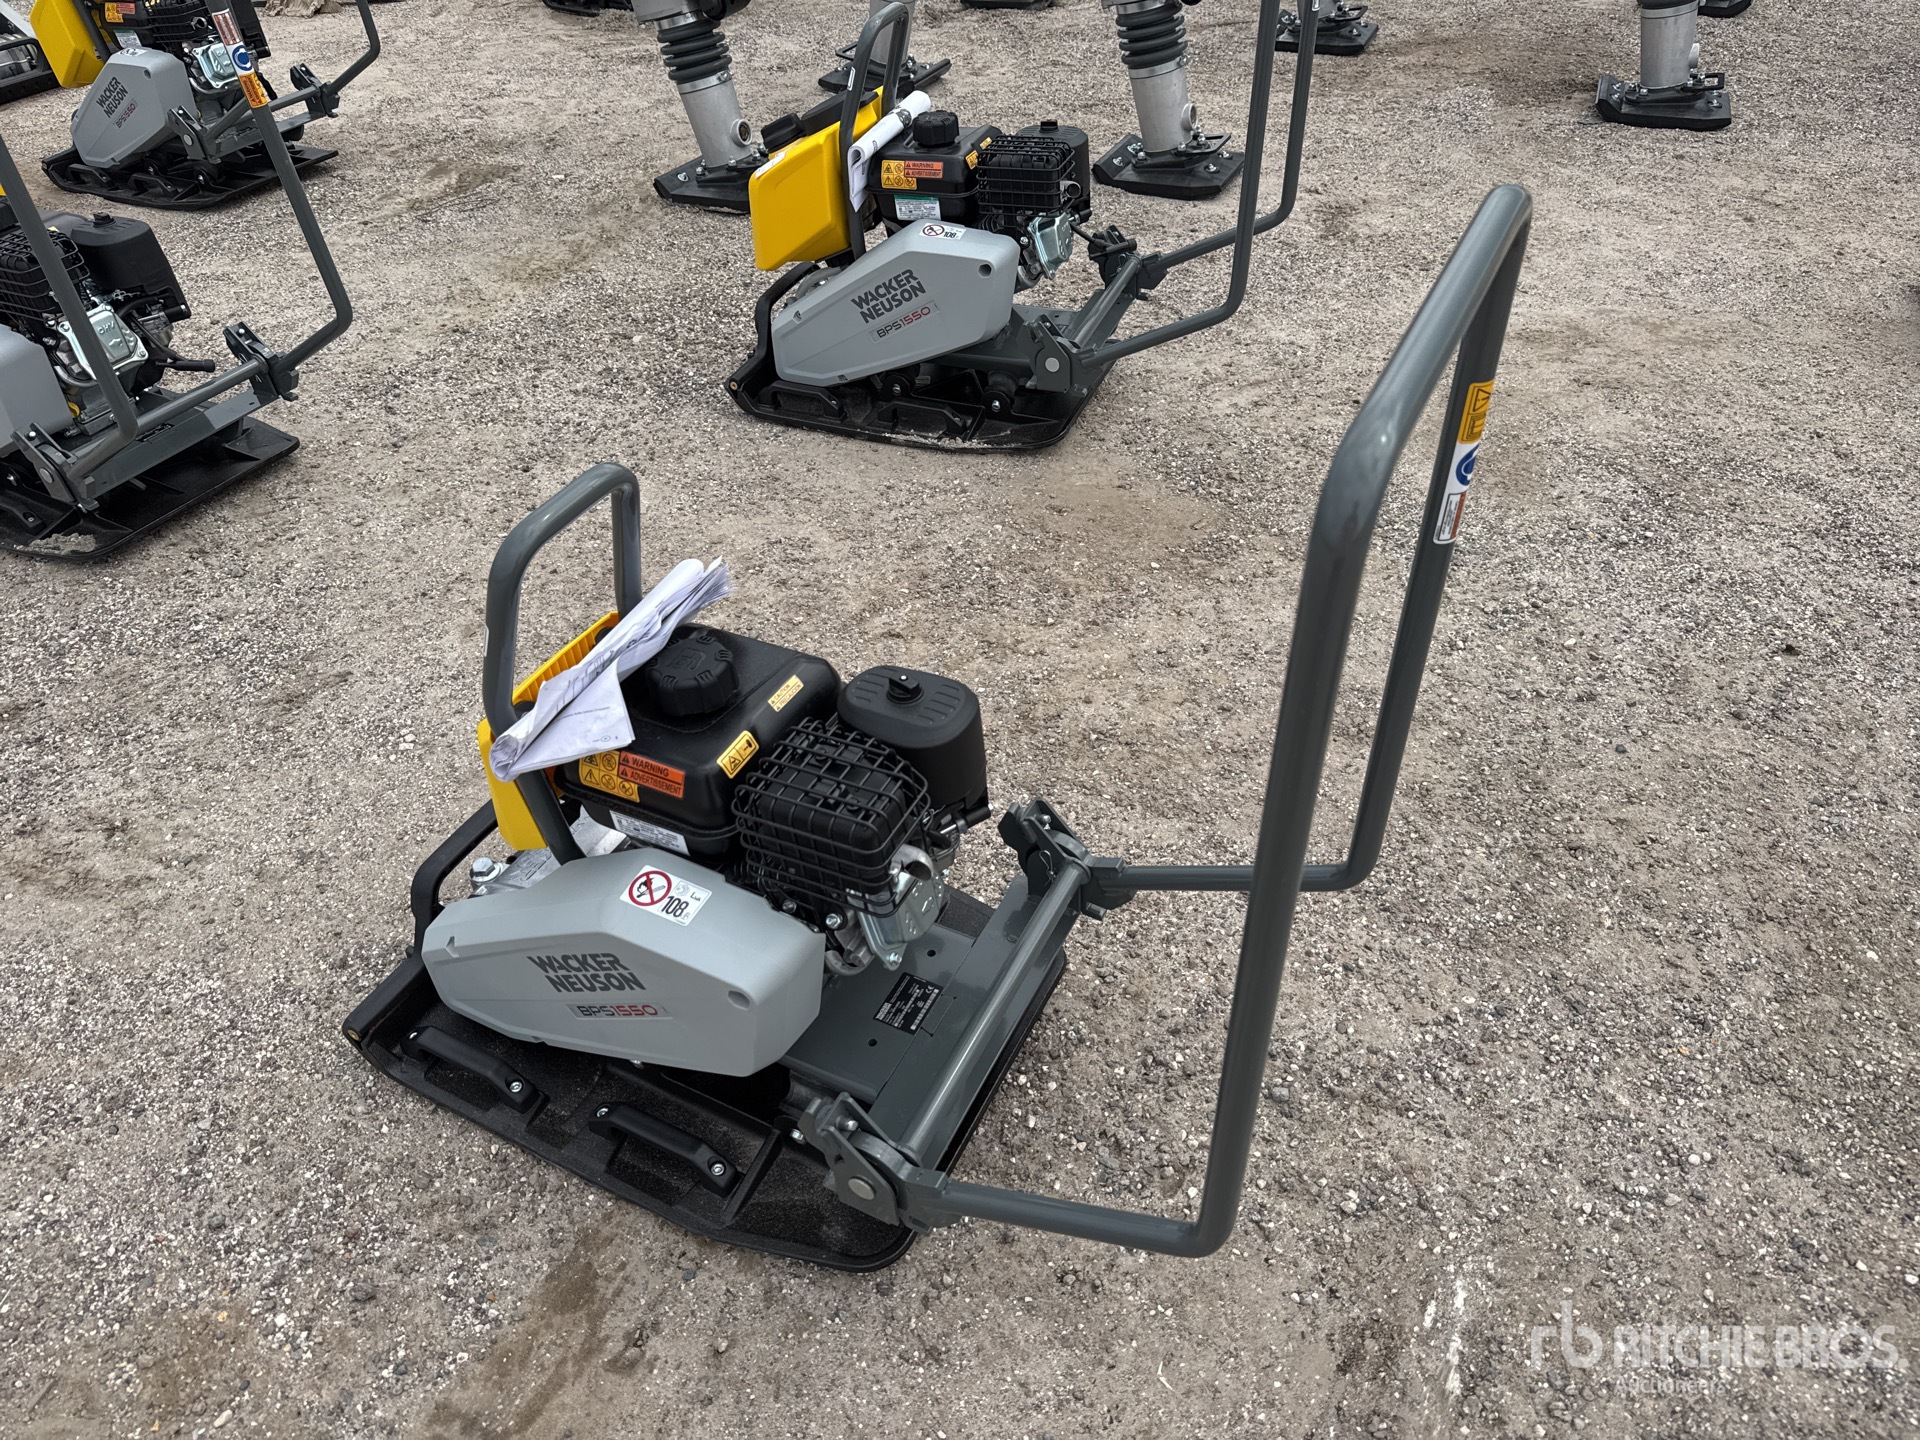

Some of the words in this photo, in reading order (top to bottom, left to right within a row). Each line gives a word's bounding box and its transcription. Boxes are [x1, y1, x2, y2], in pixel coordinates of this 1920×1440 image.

[96, 76, 122, 109] WACKER
[103, 87, 128, 118] NEUSON
[115, 104, 136, 128] BPS1550
[850, 268, 919, 310] WACKER
[860, 281, 926, 324] NEUSON
[876, 306, 931, 338] BPS1550
[631, 756, 669, 777] WARNING
[630, 770, 682, 795] ADVERTISSEMENT
[661, 895, 689, 918] 108
[526, 953, 630, 973] WACKER
[545, 972, 646, 993] NEUSON
[576, 1004, 658, 1017] BPS1550
